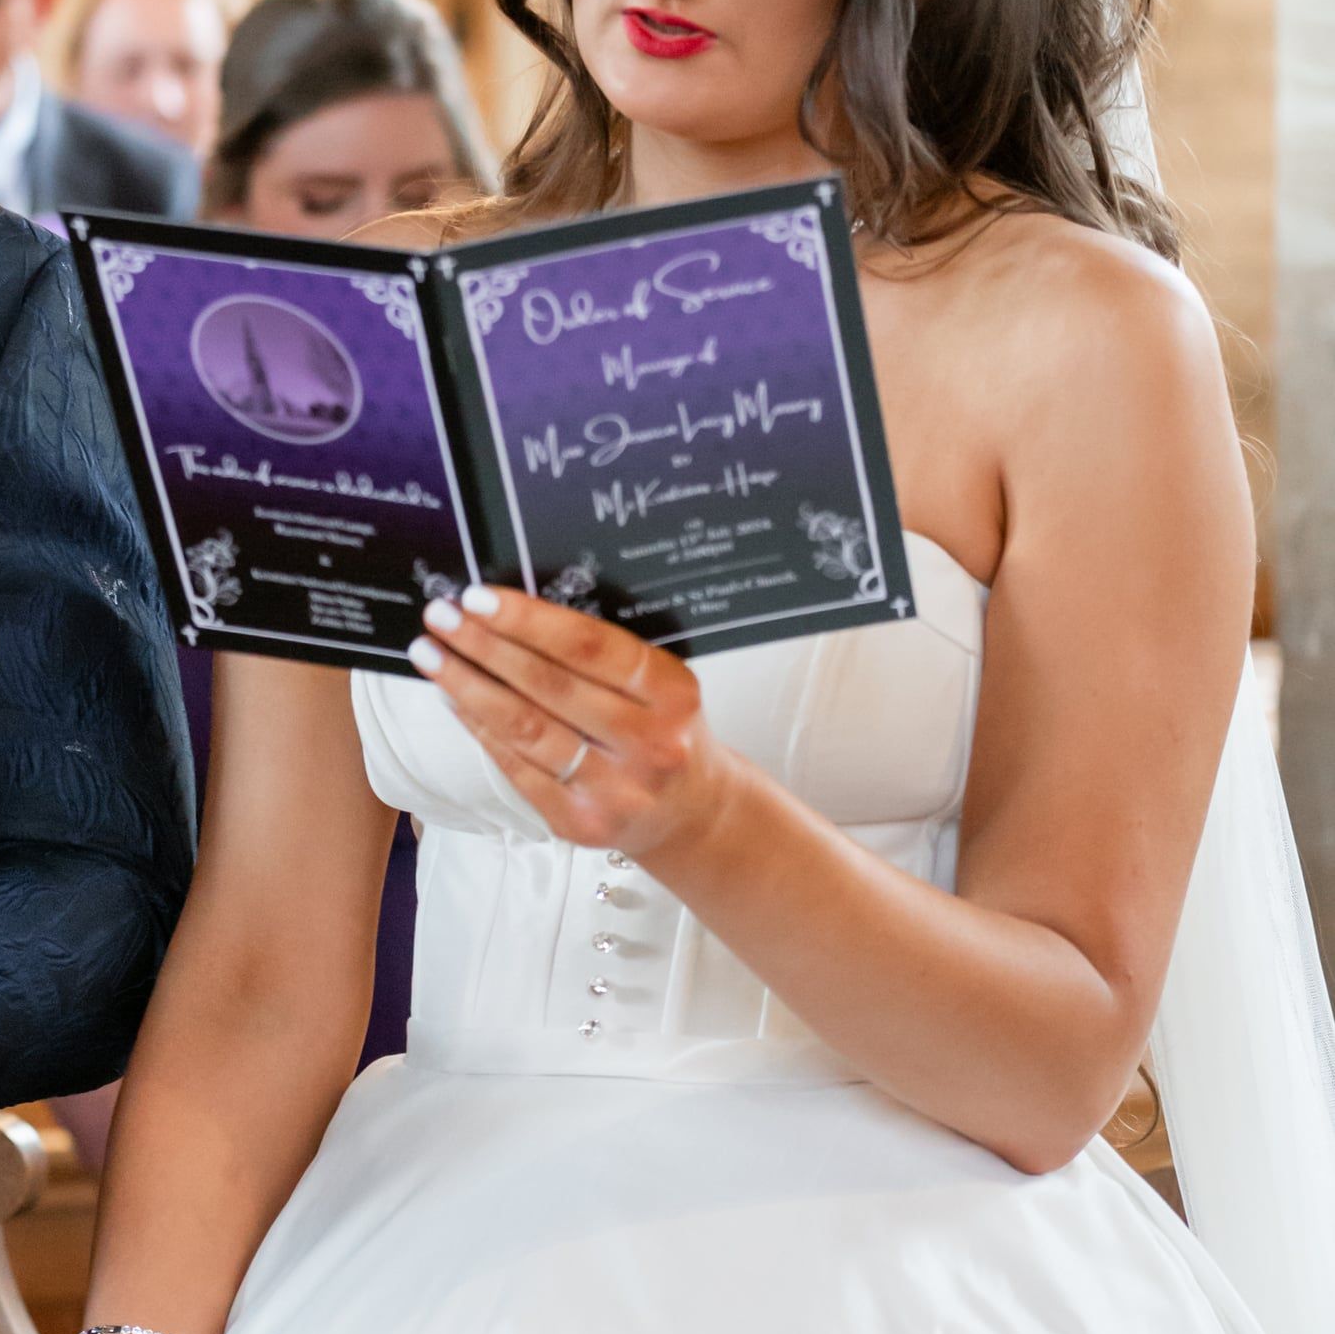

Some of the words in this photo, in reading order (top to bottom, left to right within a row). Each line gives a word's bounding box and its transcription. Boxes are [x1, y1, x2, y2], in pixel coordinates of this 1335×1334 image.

[522, 287, 619, 345] Order
[623, 278, 652, 320] of
[652, 250, 773, 314] Service
